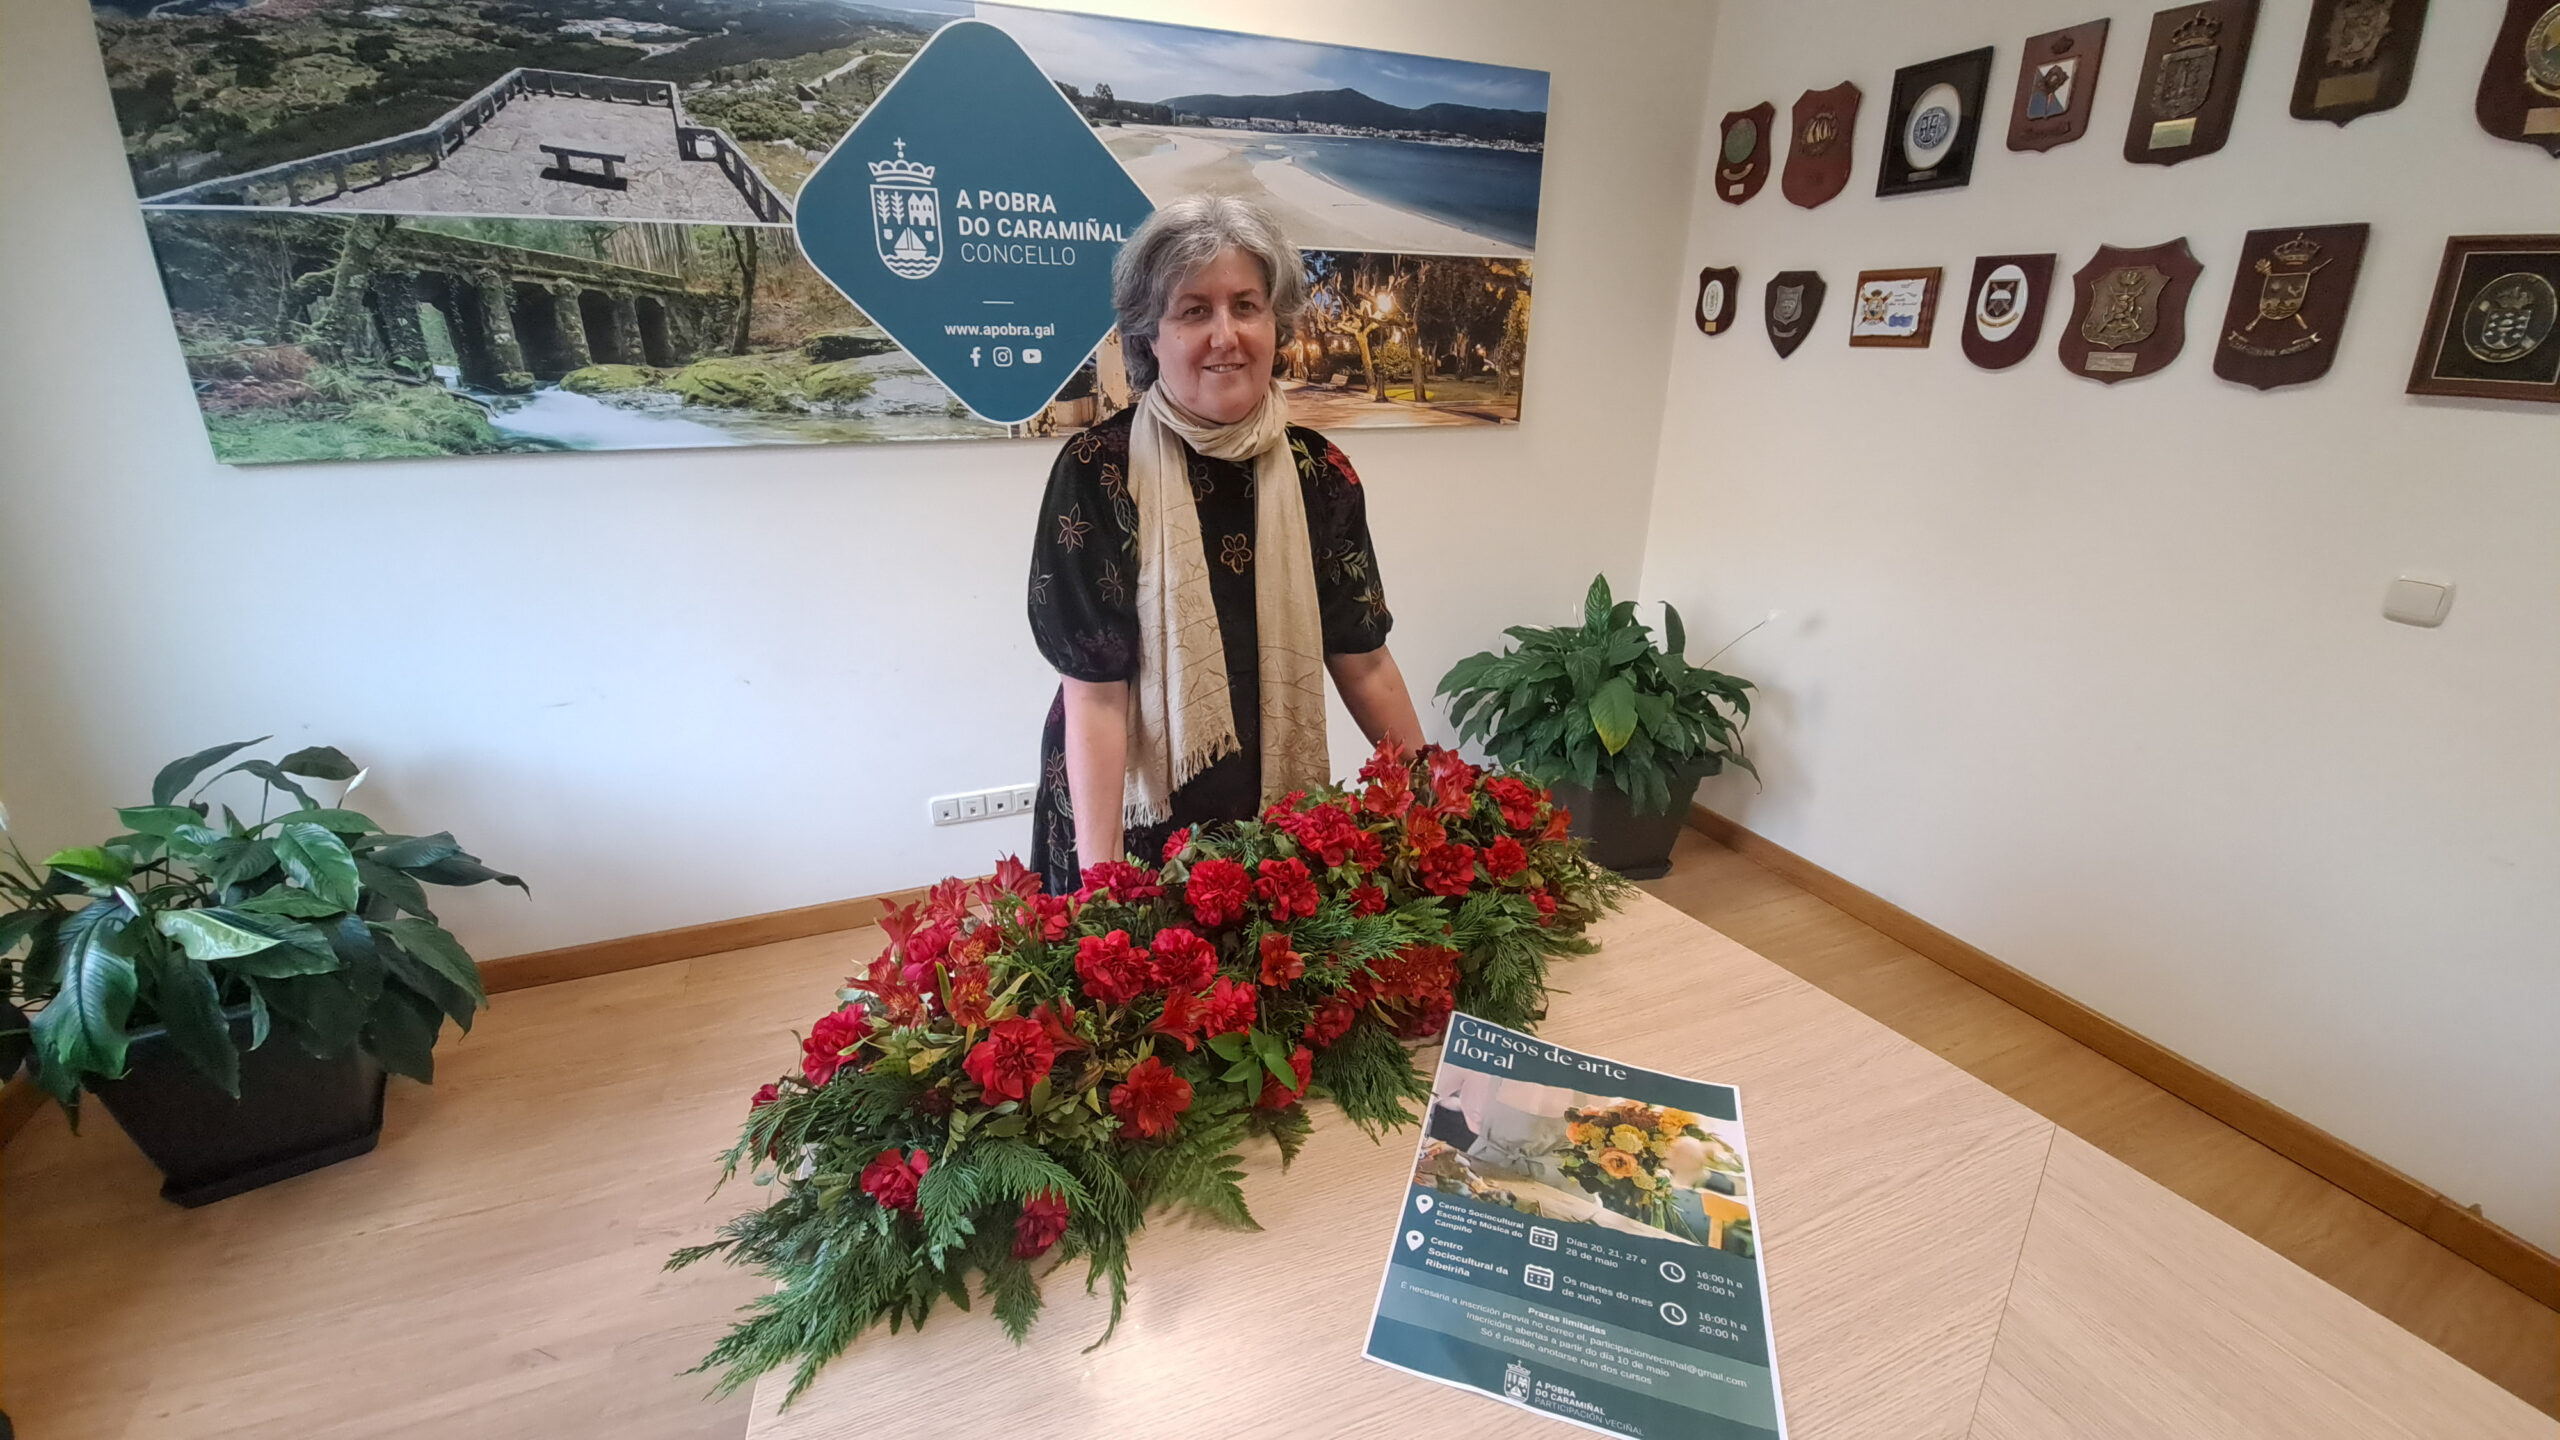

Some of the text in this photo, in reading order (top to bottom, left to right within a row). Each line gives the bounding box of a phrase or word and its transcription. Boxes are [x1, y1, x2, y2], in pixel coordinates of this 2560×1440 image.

[956, 189, 1057, 214] A POBRA
[958, 216, 1127, 242] DO CARAMIÑAL
[960, 243, 1076, 265] CONCELLO
[945, 323, 1055, 339] www.apobra.gal
[1452, 1038, 1514, 1070] floral
[1459, 1020, 1627, 1080] Cursos de arte
[1434, 1219, 1472, 1234] Campiño
[1436, 1210, 1523, 1238] Escola de Música do
[1438, 1202, 1524, 1229] Centro Sociocultural
[1430, 1237, 1463, 1251] Centro
[1567, 1237, 1588, 1249] Días
[1626, 1254, 1638, 1262] 27
[1426, 1258, 1470, 1277] Ribeiriña
[1428, 1248, 1508, 1275] Sociocultural da
[1565, 1248, 1618, 1268] 28 de maio
[1563, 1276, 1653, 1307] Os martes do mes
[1696, 1271, 1724, 1284] 16:00
[1727, 1278, 1734, 1287] h
[1697, 1282, 1735, 1298] 20:00 h
[1562, 1288, 1602, 1305] de xuño
[1409, 1284, 1450, 1301] necesaria
[1460, 1299, 1501, 1315] inscrición
[1502, 1312, 1530, 1326] previa
[1532, 1320, 1543, 1328] no
[1546, 1325, 1574, 1338] correo
[1528, 1307, 1606, 1336] Prazas limitadas
[1699, 1312, 1728, 1326] 16:00
[1730, 1320, 1737, 1329] h
[1466, 1312, 1513, 1331] Inscricións
[1515, 1327, 1549, 1341] abertas
[1559, 1340, 1582, 1353] partir
[1585, 1348, 1598, 1357] do
[1600, 1352, 1615, 1362] día
[1618, 1356, 1629, 1365] 10
[1632, 1360, 1643, 1370] de
[1646, 1365, 1670, 1377] maio
[1699, 1325, 1739, 1342] 20:00 h
[1503, 1334, 1536, 1350] posible
[1538, 1345, 1578, 1363] anotarse
[1580, 1358, 1598, 1368] nun
[1600, 1363, 1618, 1375] dos
[1620, 1369, 1652, 1384] cursos
[1536, 1380, 1576, 1398] A POBRA
[1536, 1388, 1606, 1416] DO CARAMIÑAL
[1534, 1398, 1644, 1436] PARTICIPACIÓN VECIÑAL
